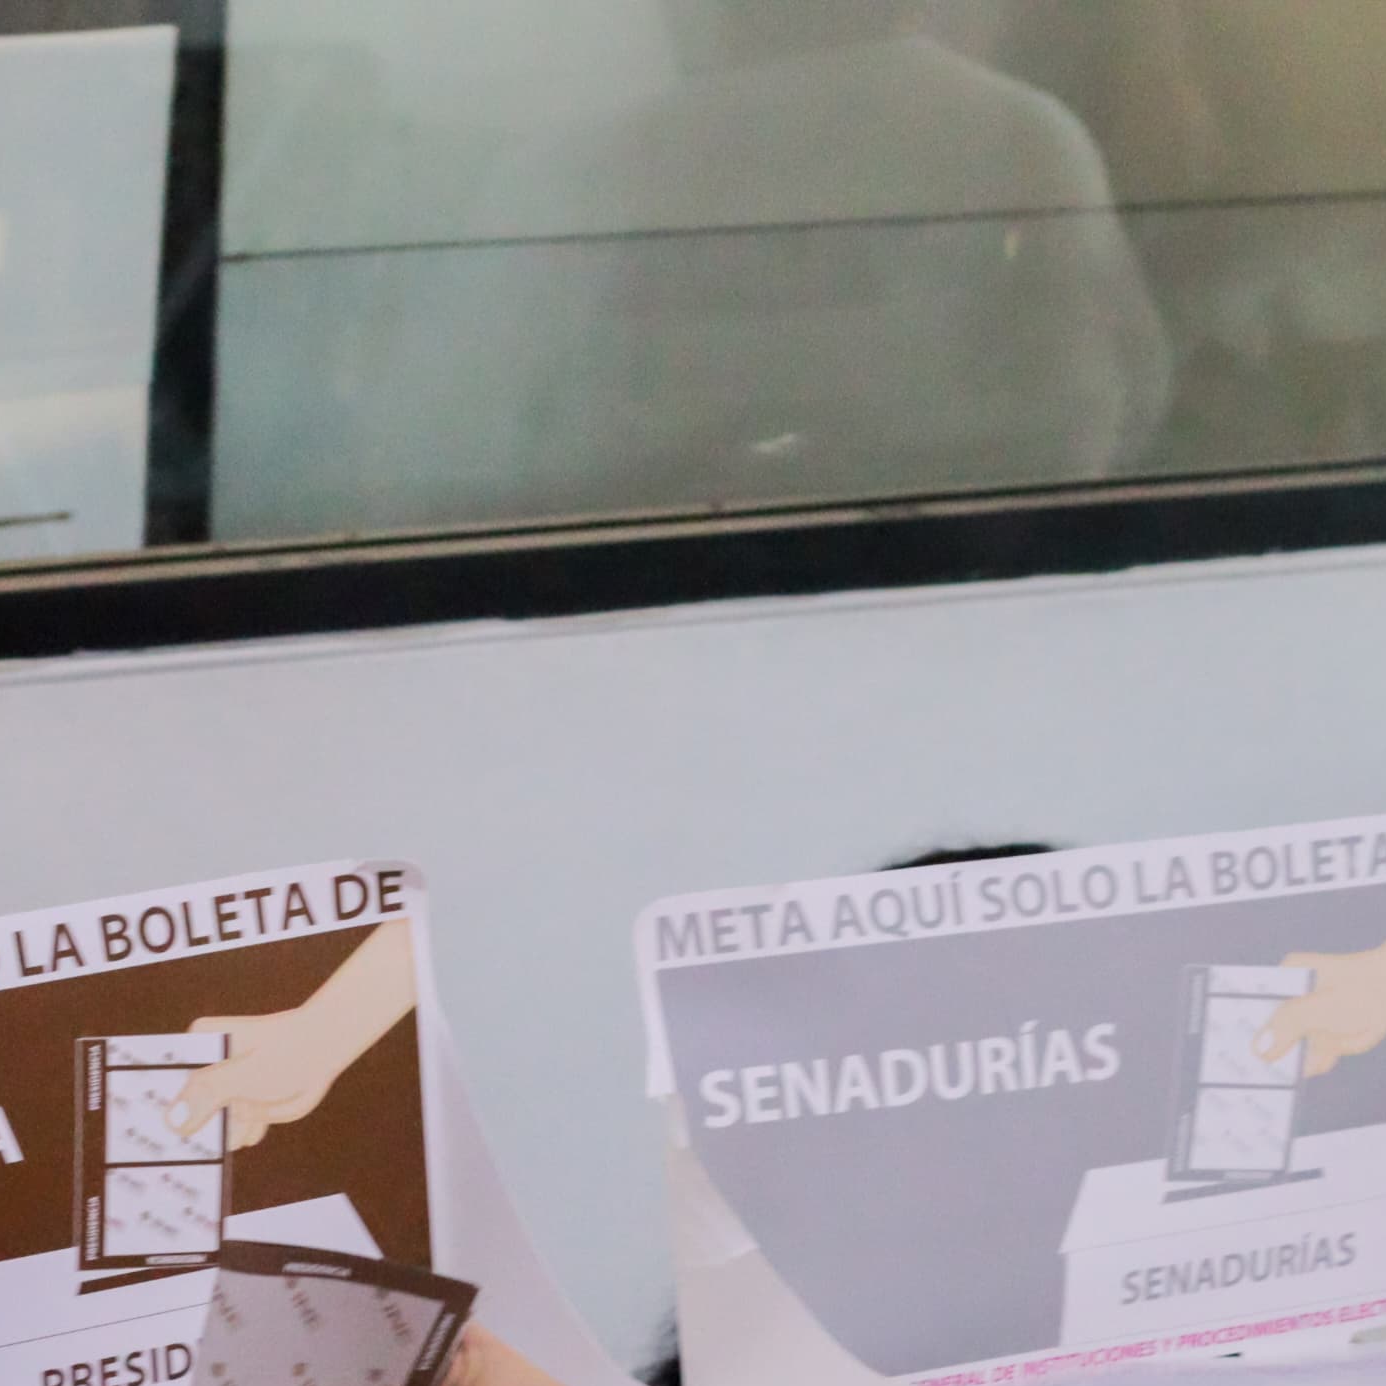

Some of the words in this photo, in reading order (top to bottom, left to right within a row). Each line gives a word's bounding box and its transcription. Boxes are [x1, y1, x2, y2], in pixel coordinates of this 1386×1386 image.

[14, 922, 86, 978] LA
[100, 882, 315, 963] BOLETA
[333, 869, 406, 921] DE
[656, 900, 816, 962] META
[829, 870, 965, 941] AQUÍ
[979, 864, 1119, 923] SOLO
[1133, 856, 1197, 905] LA
[698, 1018, 1121, 1129] SENADURÍAS
[1120, 1231, 1357, 1306] SENADURÍAS
